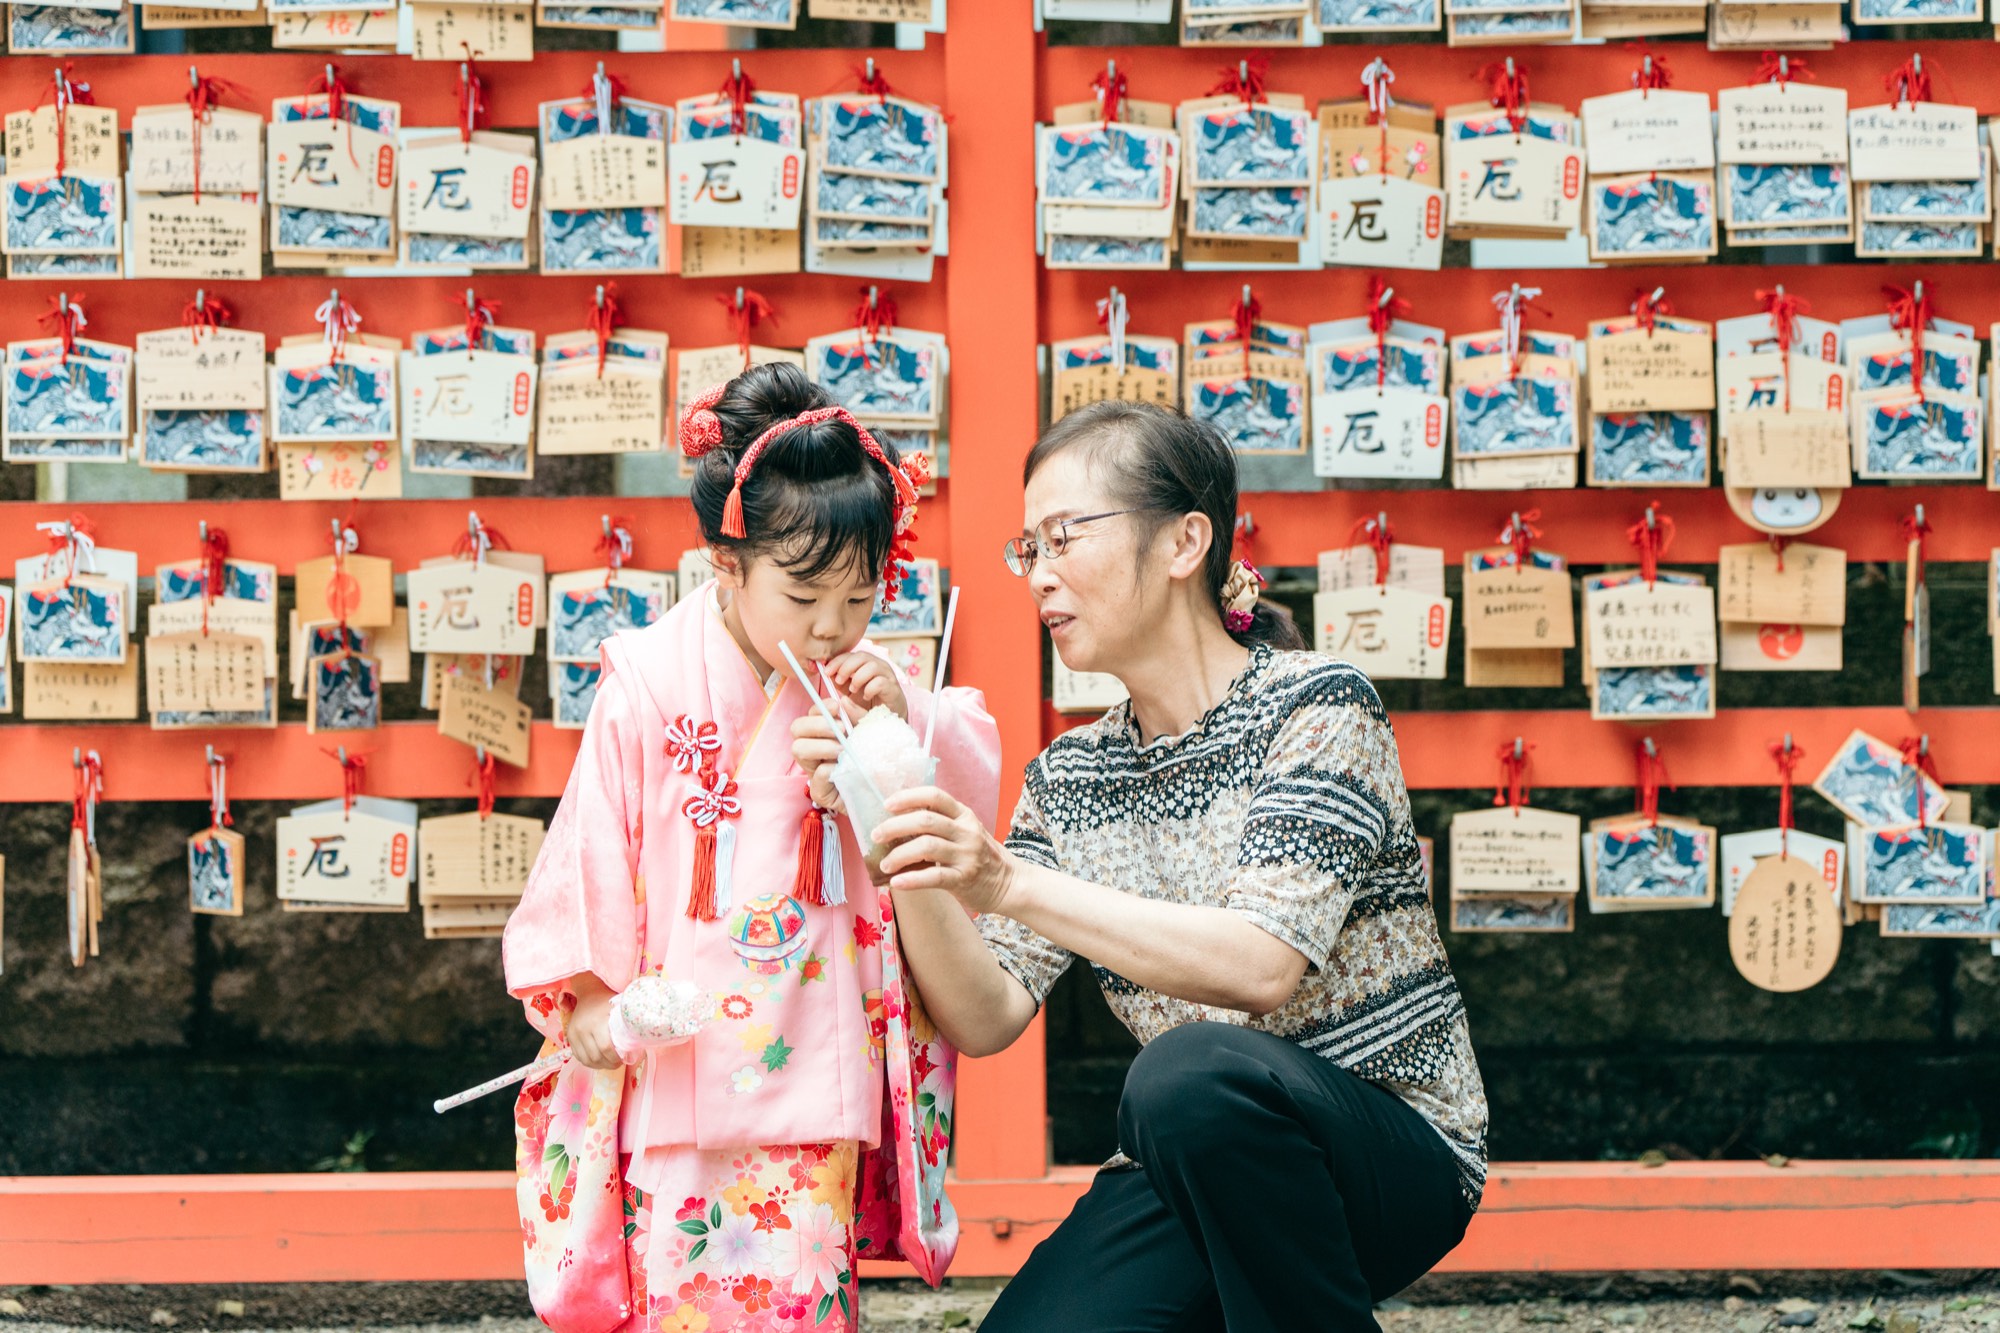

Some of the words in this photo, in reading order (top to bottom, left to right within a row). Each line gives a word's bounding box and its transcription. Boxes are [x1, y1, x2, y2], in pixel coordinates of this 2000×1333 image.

[292, 143, 339, 187] 厄
[694, 160, 742, 204] 厄
[1474, 157, 1522, 202] 厄
[423, 167, 472, 211] 厄
[1343, 198, 1388, 242] 厄
[427, 374, 472, 416] 厄
[1338, 409, 1386, 454] 厄
[433, 586, 480, 631] 厄
[1340, 608, 1388, 654] 厄
[301, 834, 351, 879] 厄
